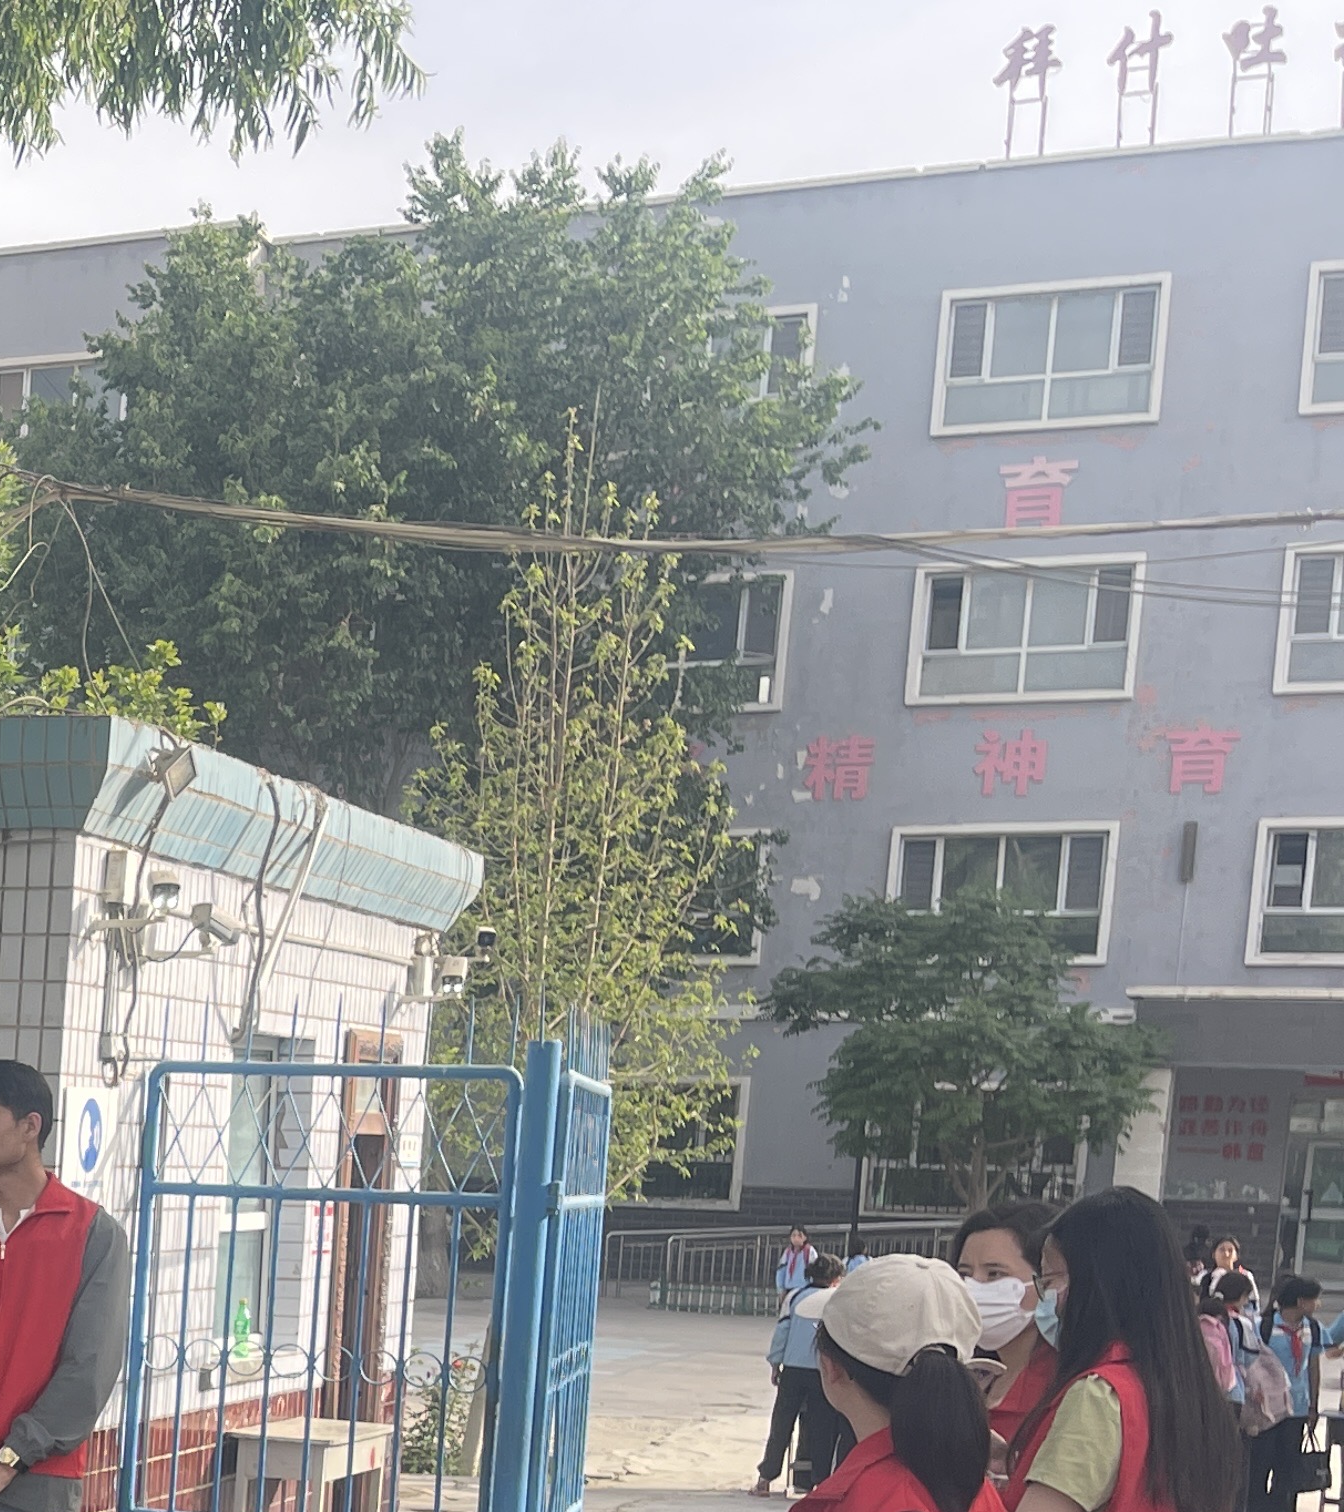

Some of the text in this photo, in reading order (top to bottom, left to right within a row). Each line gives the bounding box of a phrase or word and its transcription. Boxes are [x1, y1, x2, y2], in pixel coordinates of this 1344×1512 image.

[992, 6, 1344, 95] 拜什吐
[998, 455, 1079, 528] 育
